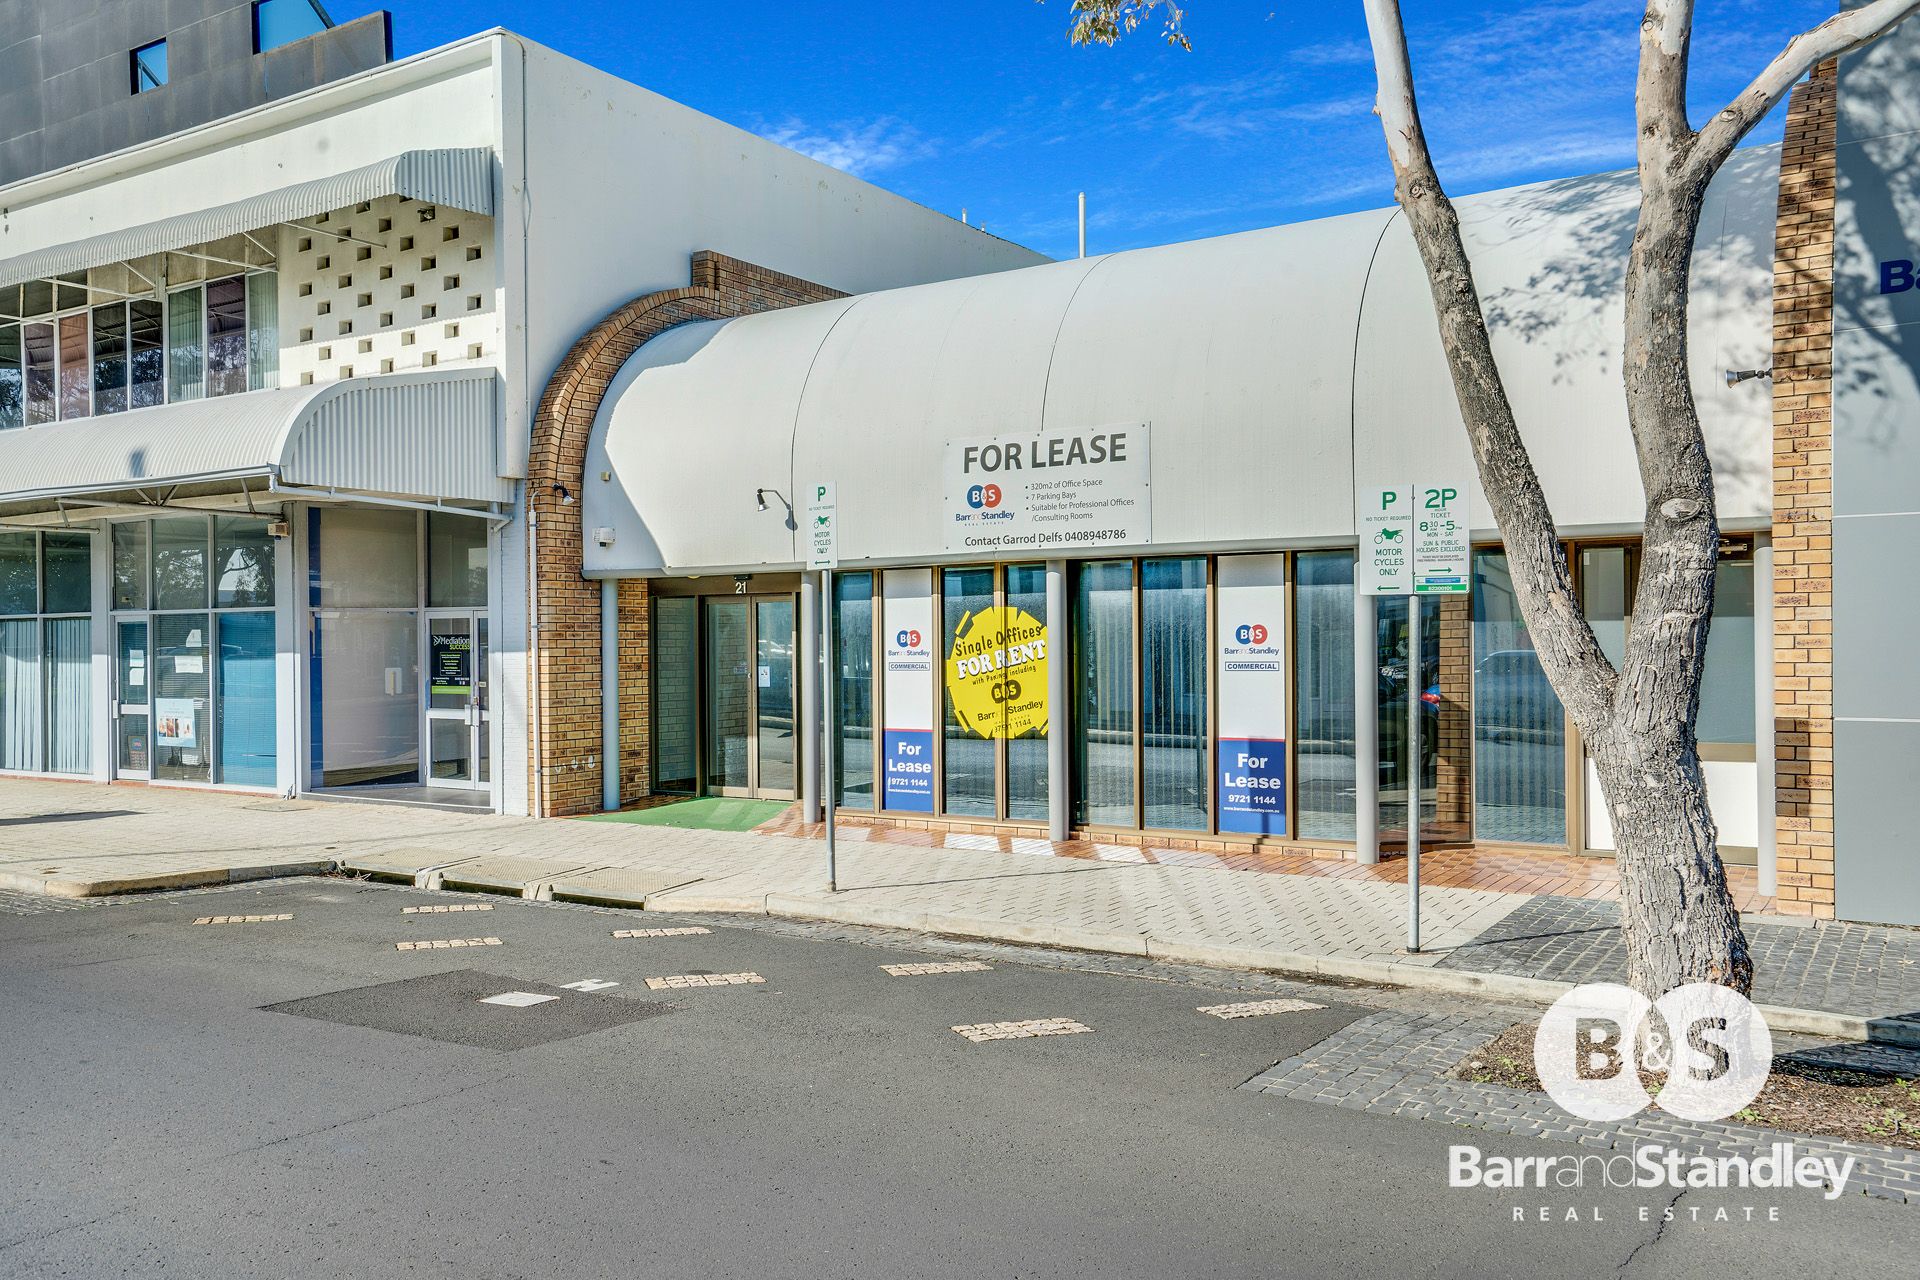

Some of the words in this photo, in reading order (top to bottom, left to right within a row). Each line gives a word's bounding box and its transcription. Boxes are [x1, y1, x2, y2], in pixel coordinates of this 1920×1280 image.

[1880, 260, 1920, 294] B
[963, 442, 1023, 474] FOR
[1031, 432, 1127, 469] LEASE
[1031, 481, 1053, 491] 320m2
[1054, 480, 1061, 489] of
[1062, 479, 1081, 488] Office
[1082, 478, 1103, 488] Space
[817, 486, 827, 502] P
[1037, 492, 1061, 502] Parking
[1062, 491, 1077, 501] Bays
[1382, 491, 1397, 510] P
[1424, 488, 1458, 509] 2P
[1031, 503, 1057, 513] Suitable
[1058, 502, 1067, 511] for
[1069, 499, 1109, 510] Professional
[1110, 498, 1135, 507] Offices
[1070, 511, 1093, 520] Rooms
[1420, 521, 1429, 532] 8
[965, 533, 1001, 547] Contact
[1002, 531, 1036, 546] Garrod
[1038, 530, 1063, 543] Delfs
[1065, 529, 1127, 542] 0408948786
[1375, 548, 1402, 556] MOTOR
[1374, 558, 1404, 566] CYCLES
[1379, 568, 1399, 576] ONLY
[735, 581, 747, 594] 21
[955, 635, 993, 657] Single
[995, 625, 1041, 645] Offices
[956, 653, 994, 680] FOR
[994, 639, 1046, 671] RENT
[978, 711, 996, 721] Barr
[1007, 700, 1044, 714] Standley
[898, 742, 922, 756] For
[888, 758, 932, 774] Lease
[1237, 753, 1268, 769] For
[891, 778, 908, 786] 9721
[910, 779, 928, 787] 1144
[1224, 772, 1281, 790] Lease
[1228, 794, 1251, 803] 9721
[1253, 795, 1276, 805] 1144
